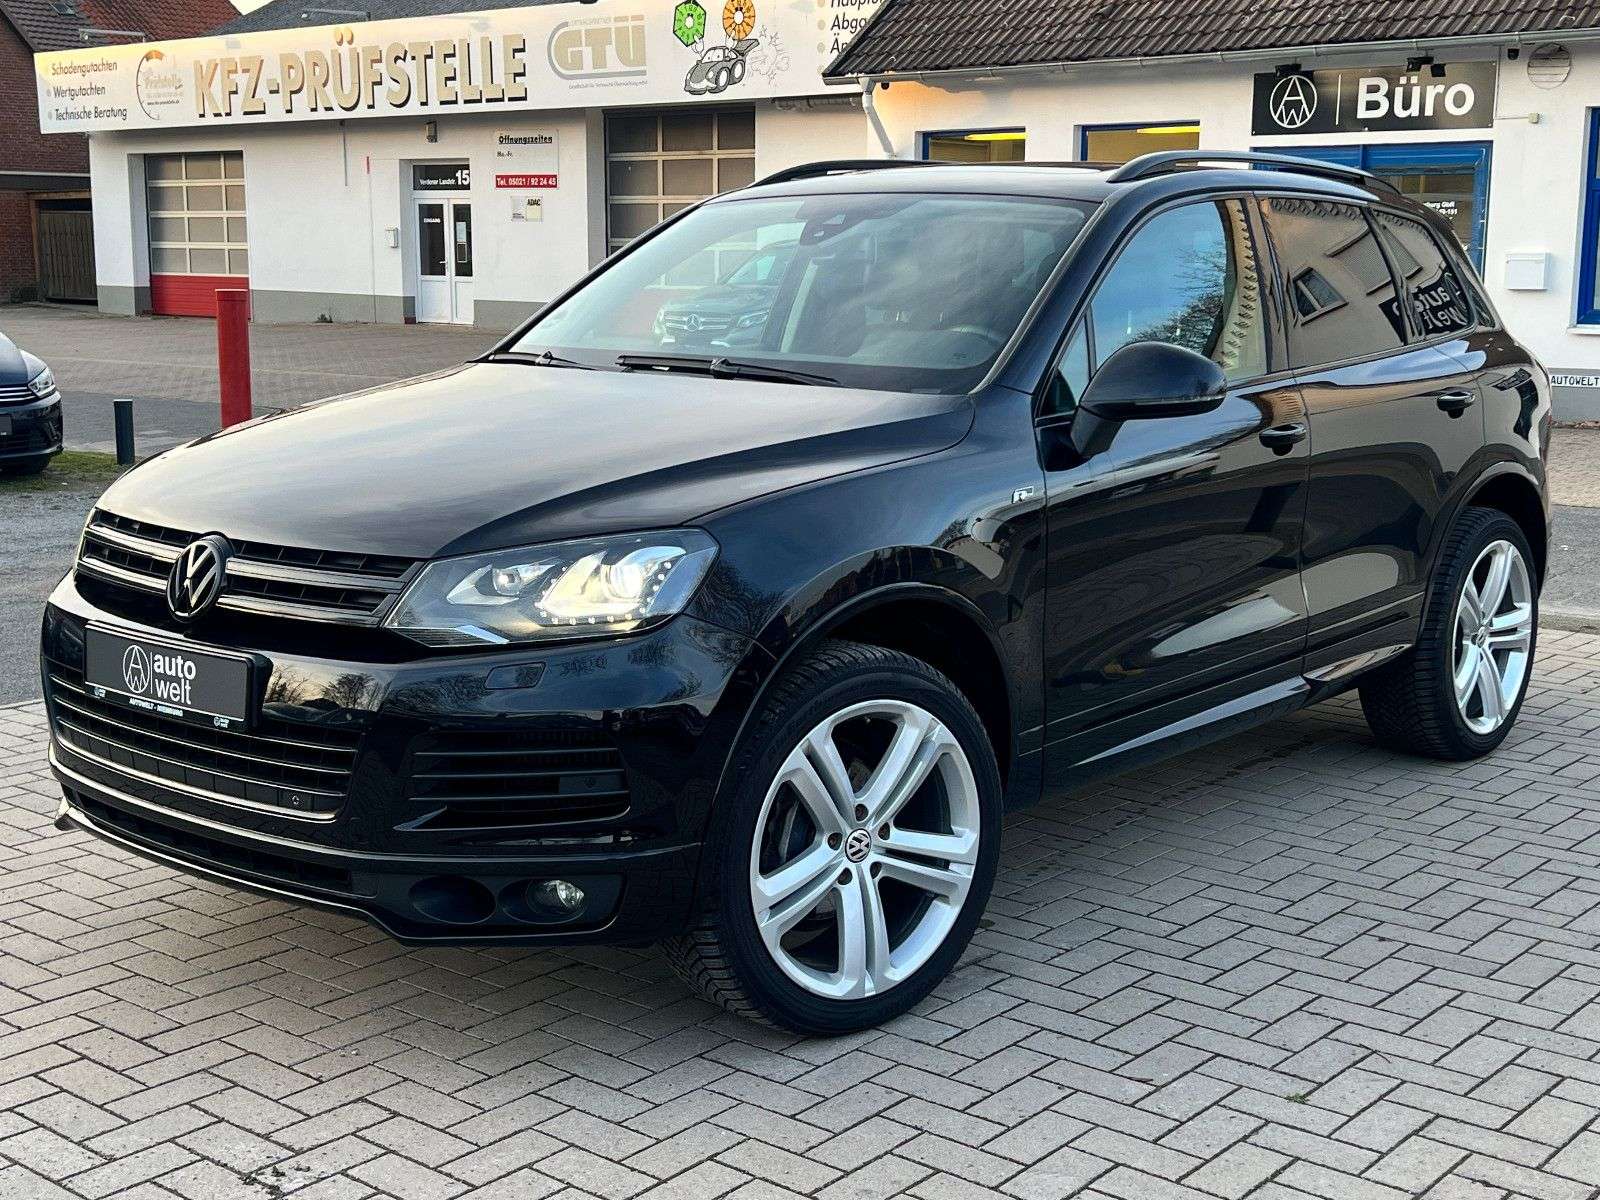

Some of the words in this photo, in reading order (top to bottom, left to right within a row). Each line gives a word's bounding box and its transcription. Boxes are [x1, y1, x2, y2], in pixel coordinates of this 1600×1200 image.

[830, 12, 867, 33] Abga
[51, 58, 118, 77] Schadengutachten
[193, 27, 527, 118] KFZ-PRÜFSTELLE
[53, 83, 106, 101] Wertgutachten
[1356, 76, 1475, 119] Büro
[55, 105, 92, 121] Technische
[94, 105, 127, 121] Beratung
[456, 169, 471, 186] 15
[497, 177, 506, 186] Tel.
[1551, 375, 1600, 387] AUTOWELT
[153, 653, 197, 680] auto
[155, 678, 192, 705] welt
